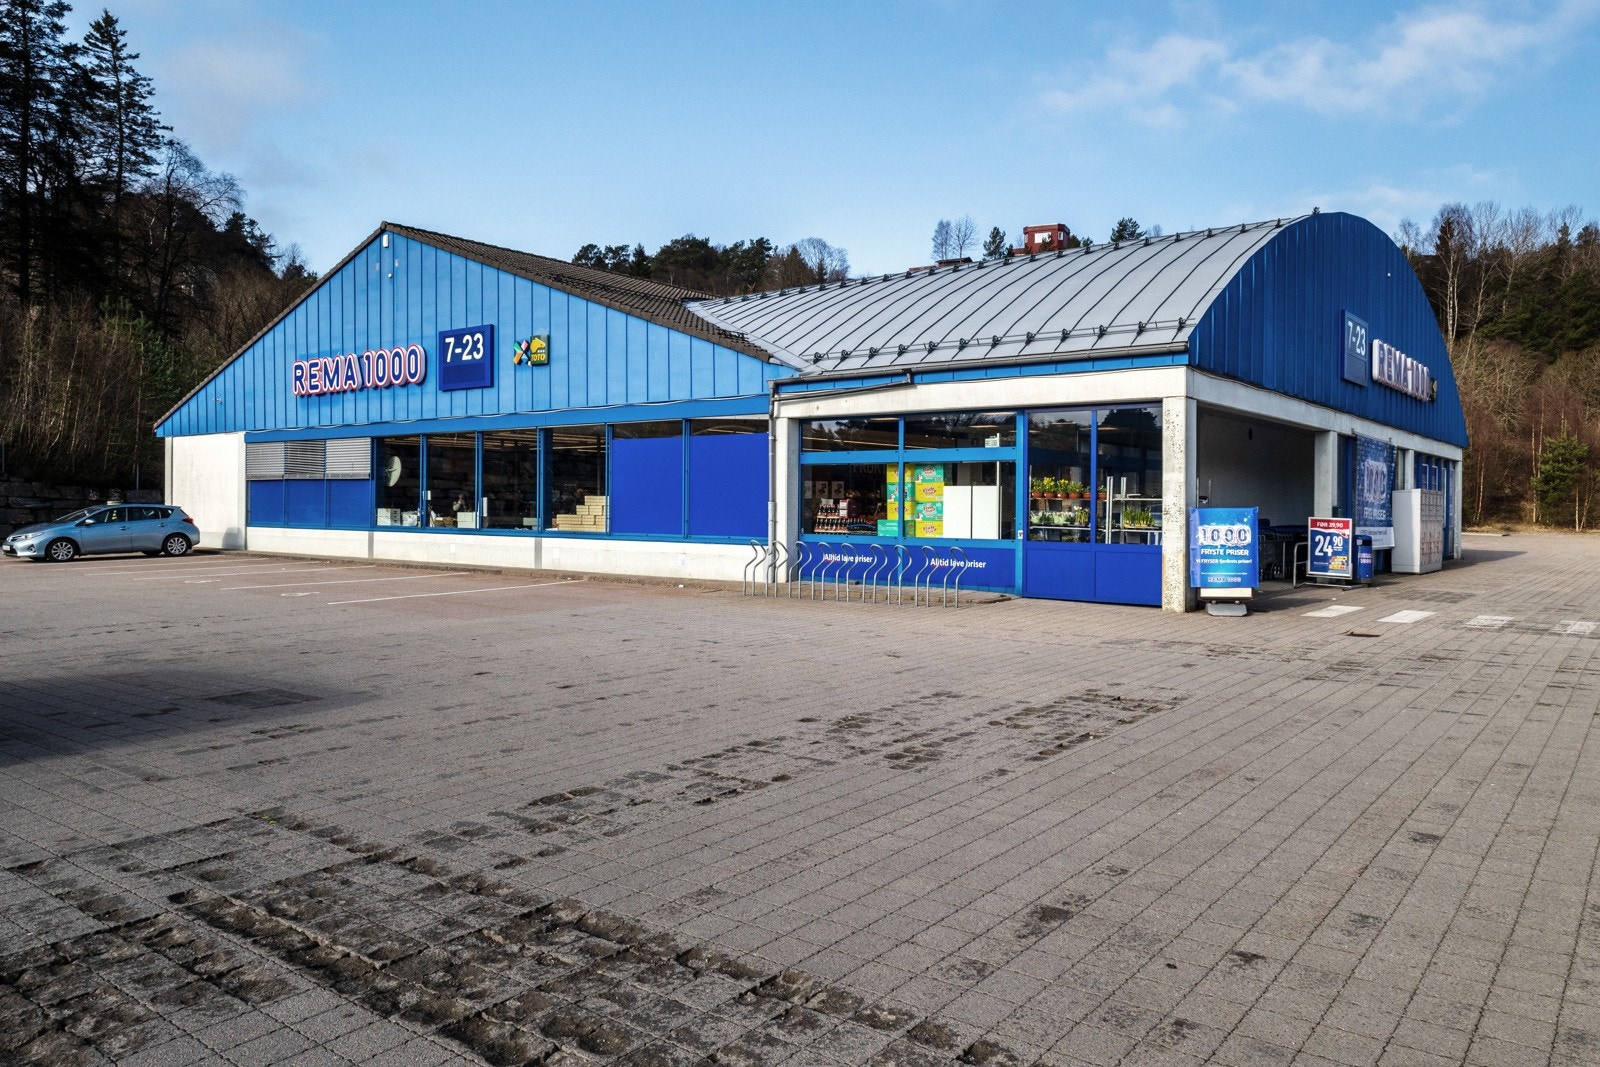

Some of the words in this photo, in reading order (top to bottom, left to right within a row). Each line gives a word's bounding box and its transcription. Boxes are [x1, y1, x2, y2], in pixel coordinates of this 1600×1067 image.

[445, 332, 485, 363] 7-23
[1347, 320, 1367, 357] 7-23
[292, 353, 361, 396] REMA
[362, 343, 425, 388] 1000
[1201, 527, 1249, 544] 1000
[1314, 535, 1333, 557] 24
[1332, 535, 1343, 547] 90
[1200, 548, 1224, 556] FRYSTE
